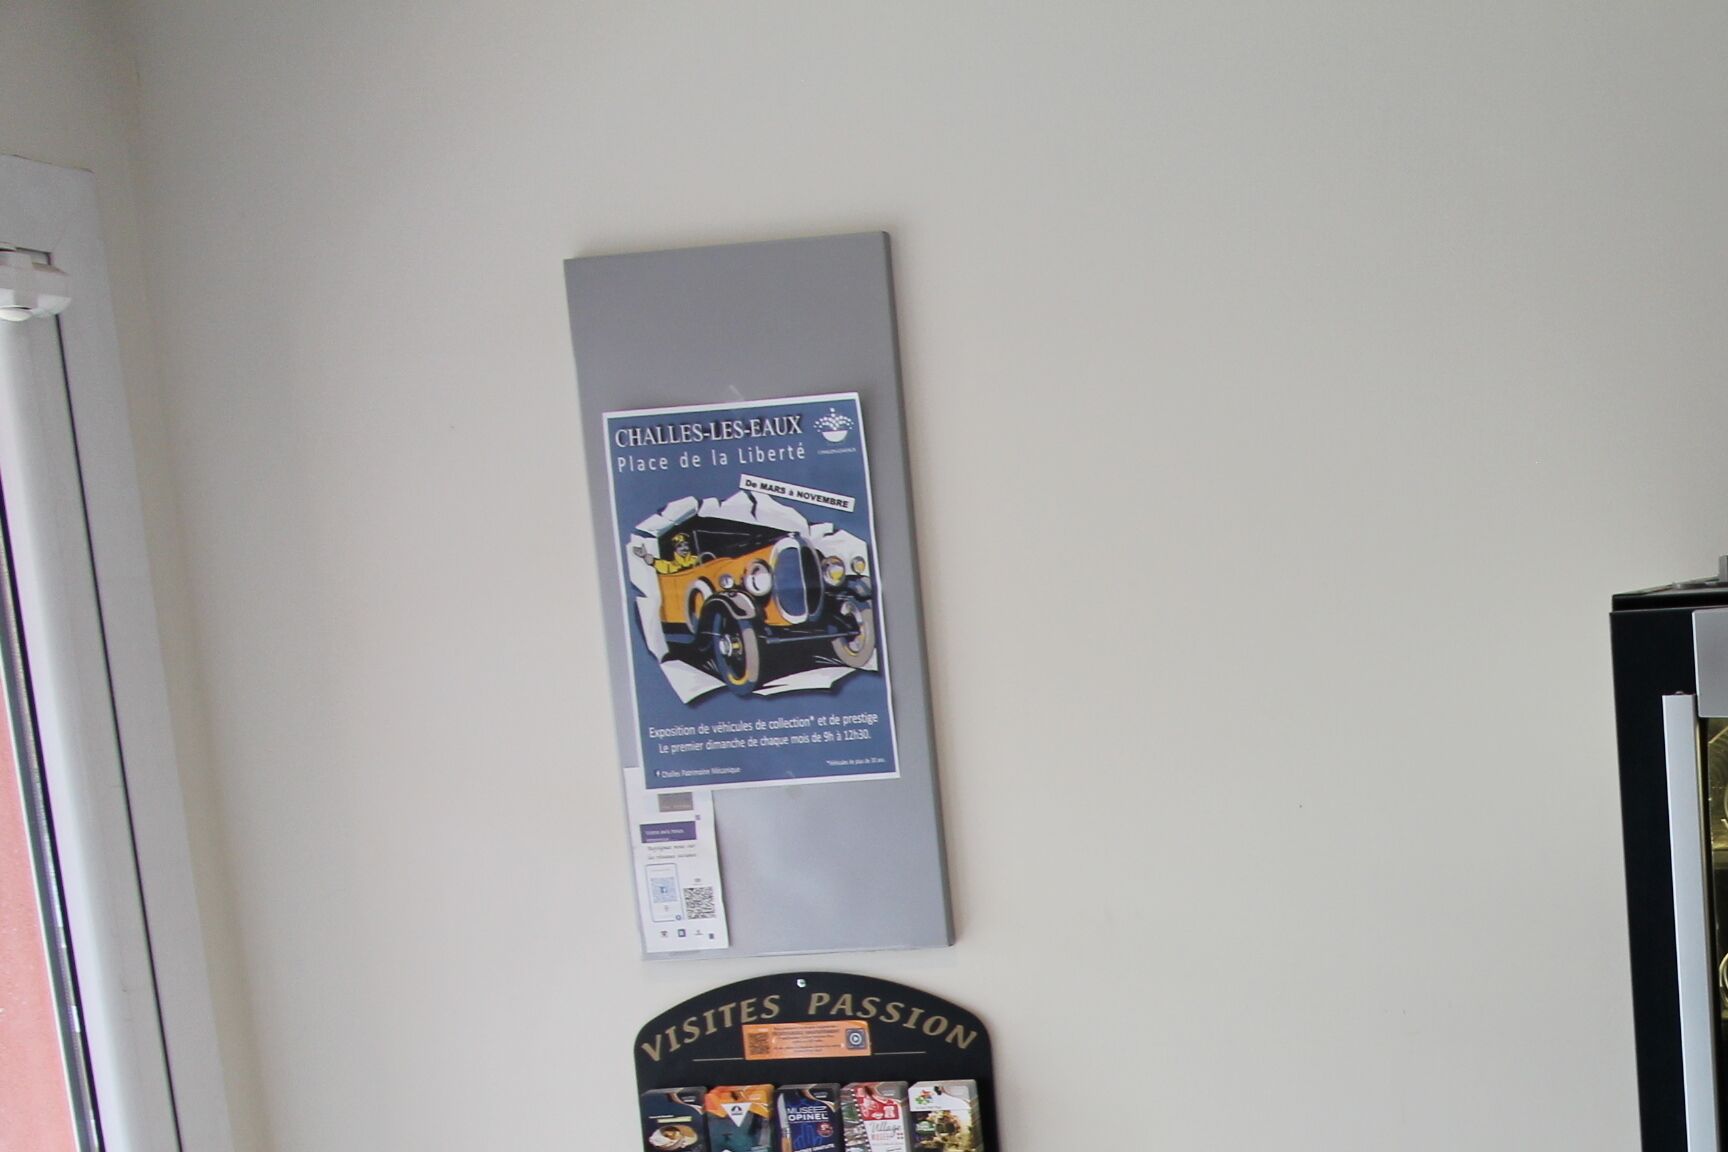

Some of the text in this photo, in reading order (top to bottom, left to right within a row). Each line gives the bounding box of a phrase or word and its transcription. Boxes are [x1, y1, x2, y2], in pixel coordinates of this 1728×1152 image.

[615, 415, 803, 448] CHALLES-LES-EAUX
[617, 456, 668, 473] Place
[680, 452, 700, 468] de
[712, 450, 728, 465] la
[739, 443, 805, 464] Liberté
[745, 479, 758, 488] De
[760, 482, 786, 495] MARS
[796, 490, 849, 508] NOVEMBRE
[648, 725, 696, 739] Exposition
[698, 723, 710, 734] de
[711, 720, 753, 733] véhicules
[755, 719, 766, 730] de
[817, 715, 827, 726] et
[829, 714, 840, 726] de
[842, 712, 878, 726] prestige
[659, 743, 669, 754] Le
[671, 741, 704, 755] premier
[705, 738, 746, 750] dimanche
[747, 737, 758, 747] de
[760, 735, 789, 747] chaque
[790, 733, 810, 744] mois
[811, 732, 822, 743] de
[823, 731, 834, 742] 9h
[836, 731, 842, 741] à
[641, 993, 783, 1062] VISITES
[807, 992, 978, 1050] PASSION
[788, 1113, 829, 1121] OPINEL
